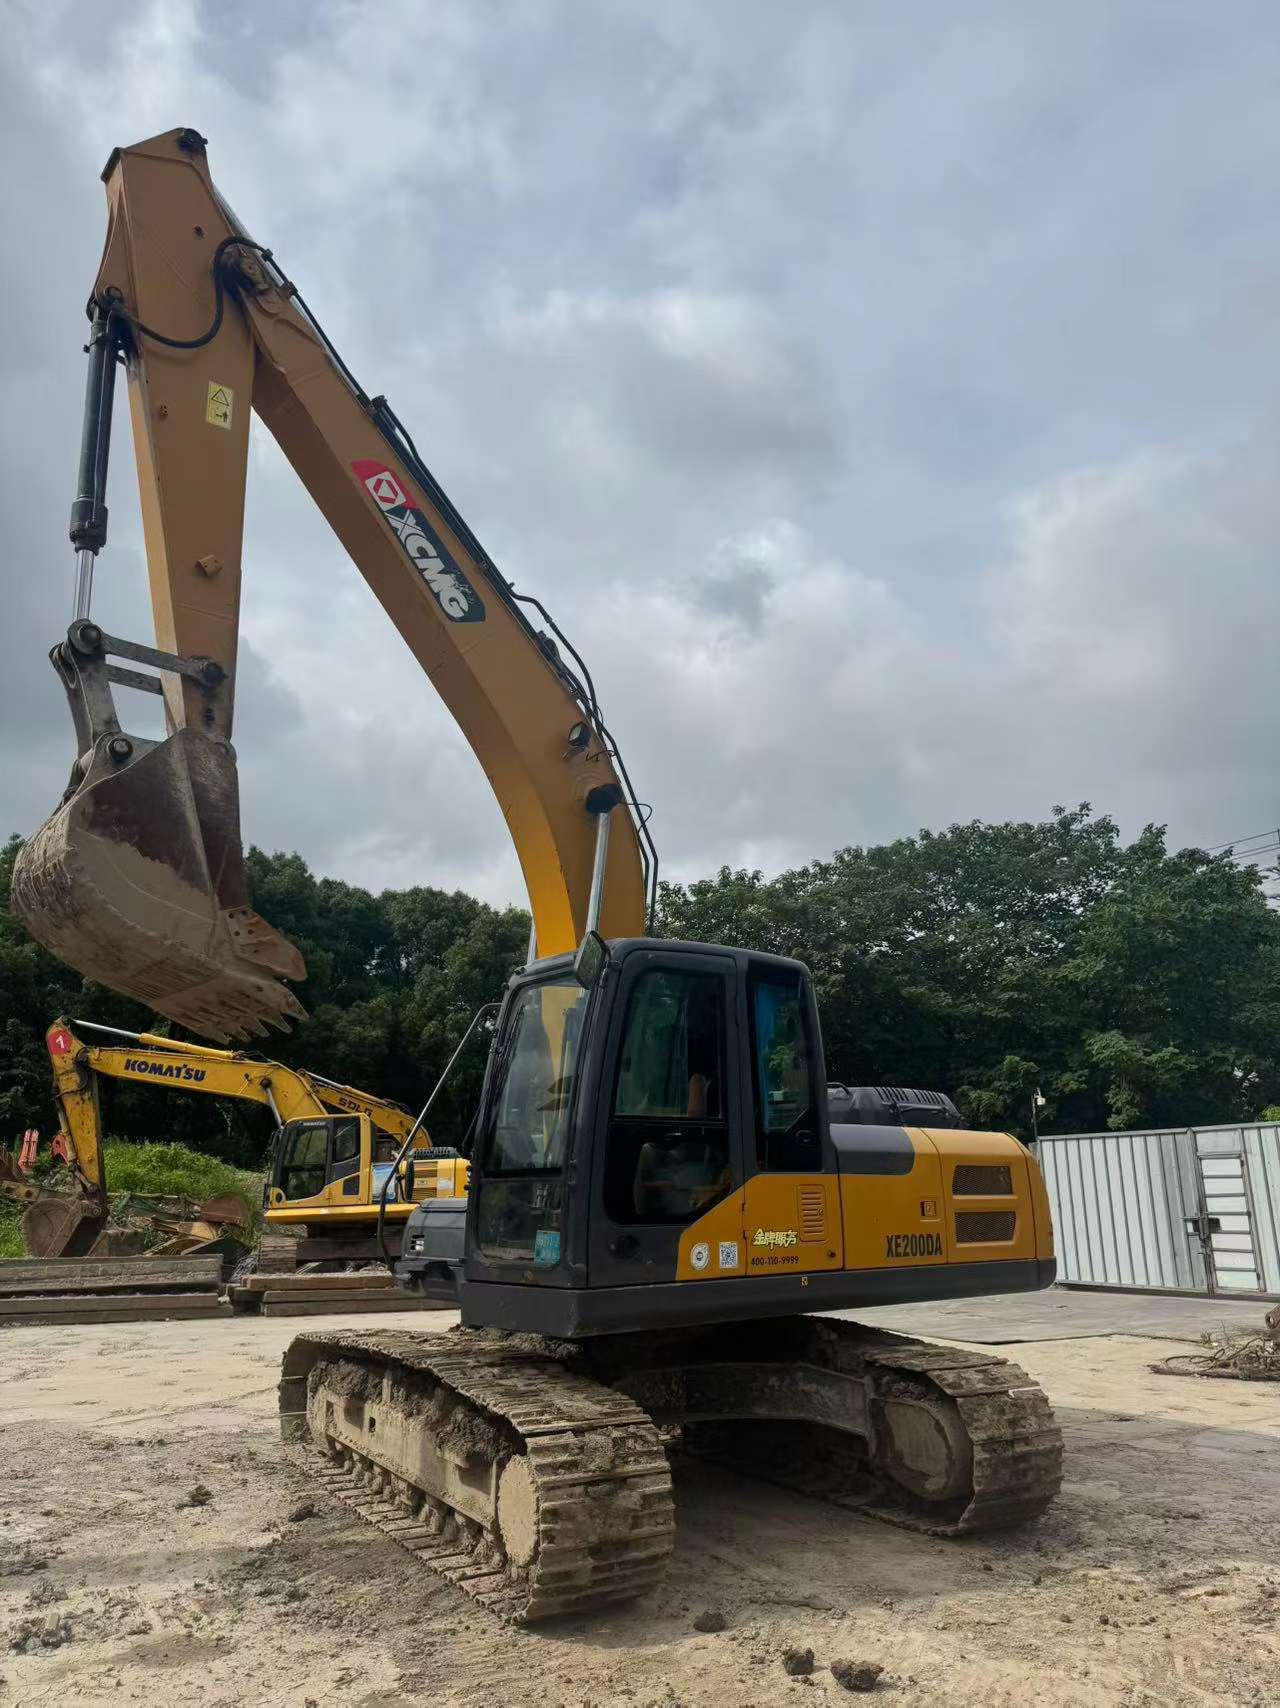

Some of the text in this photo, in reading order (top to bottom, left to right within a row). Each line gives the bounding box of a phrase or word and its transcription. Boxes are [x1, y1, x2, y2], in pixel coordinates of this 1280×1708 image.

[384, 508, 470, 618] XCMG
[55, 1034, 65, 1049] 1
[124, 1058, 207, 1082] KOMATSU
[886, 1232, 943, 1258] XE200DA
